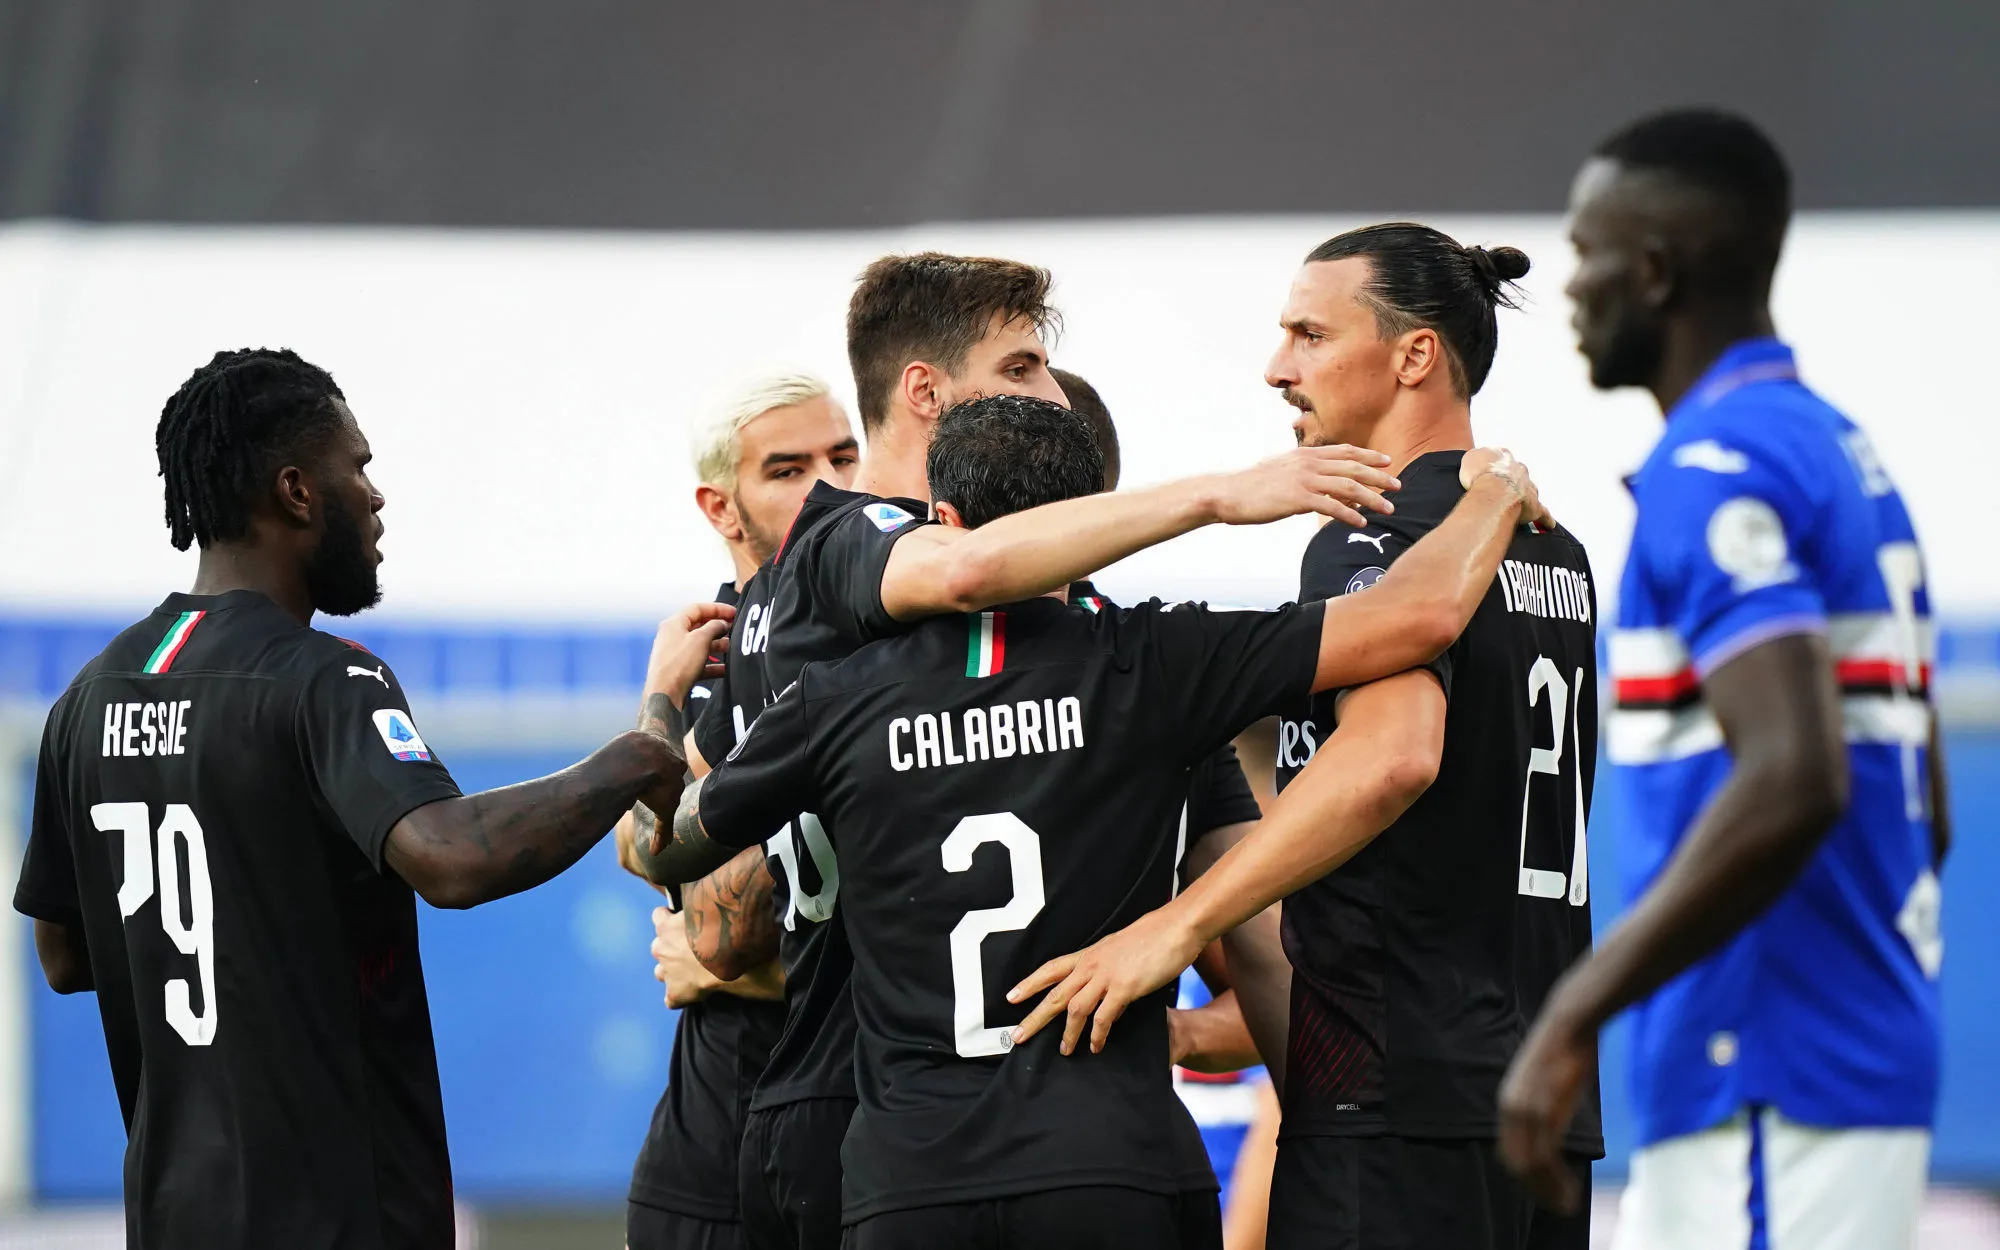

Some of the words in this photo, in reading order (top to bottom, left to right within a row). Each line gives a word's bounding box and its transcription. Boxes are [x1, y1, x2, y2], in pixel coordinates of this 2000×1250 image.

[102, 700, 191, 757] KESSIE
[888, 696, 1085, 772] CALABRIA
[1518, 654, 1588, 907] 21
[90, 802, 218, 1046] 79
[940, 811, 1046, 1058] 2
